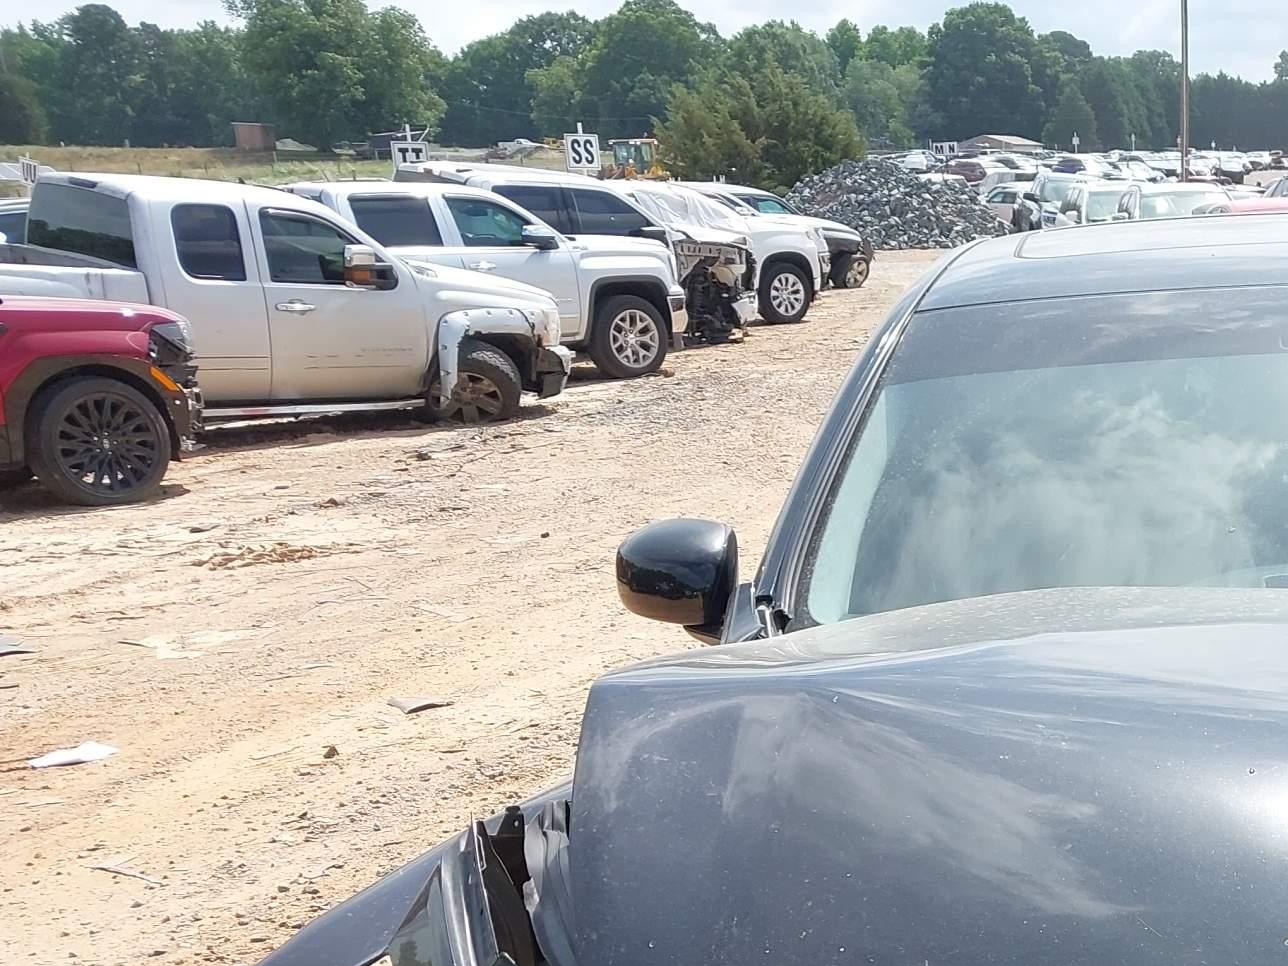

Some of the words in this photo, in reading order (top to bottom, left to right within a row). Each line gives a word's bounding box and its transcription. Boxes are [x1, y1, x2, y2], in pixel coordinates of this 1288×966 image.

[397, 147, 424, 163] TT
[571, 138, 595, 165] SS
[934, 144, 944, 154] M
[948, 143, 955, 154] N
[22, 161, 37, 184] UU
